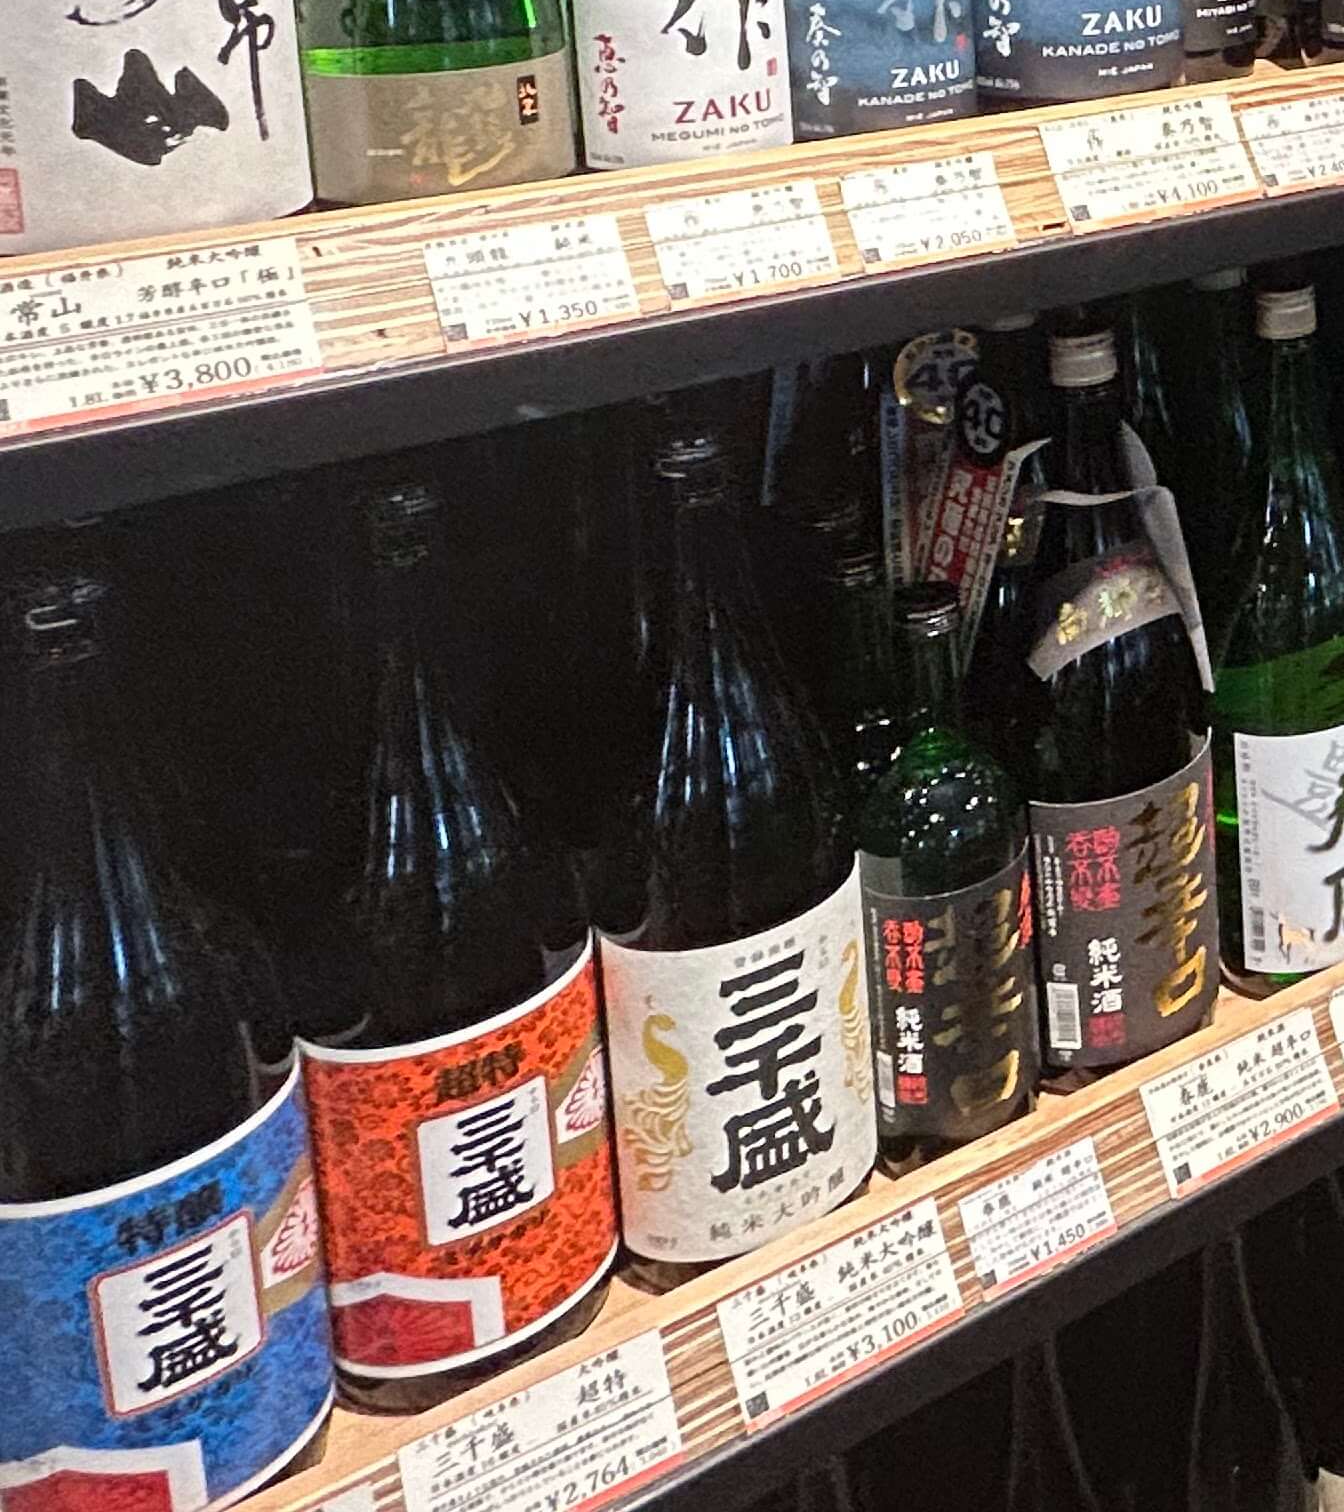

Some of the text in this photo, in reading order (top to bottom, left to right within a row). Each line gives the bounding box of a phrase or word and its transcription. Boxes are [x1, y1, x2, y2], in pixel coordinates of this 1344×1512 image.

[1081, 4, 1163, 37] ZAKU
[1042, 40, 1122, 58] KANADE
[890, 58, 961, 89] ZAKU
[672, 88, 775, 125] ZAKU
[857, 91, 926, 108] KANADE
[651, 126, 727, 144] MEGUMI
[9, 292, 83, 328] 常山
[517, 299, 599, 330] ¥1,350
[138, 356, 253, 397] ¥3,800
[1086, 937, 1125, 1015] 純米酒
[895, 1005, 925, 1074] 純米酒
[706, 949, 837, 1194] 三千盛
[1236, 1048, 1267, 1077] 純米
[1178, 1074, 1212, 1107] 春鹿
[1248, 1102, 1305, 1145] ¥2,900
[447, 1097, 535, 1228] 三千盛
[708, 1165, 847, 1244] 純米大吟醸
[838, 1219, 936, 1284] 純米大吟醸
[1030, 1223, 1086, 1262] ¥1,450
[137, 1244, 238, 1393] 三千盛
[748, 1280, 816, 1329] 三千盛
[846, 1310, 919, 1362] ¥3,100
[577, 1367, 627, 1406] 超特
[434, 1420, 515, 1479] 三千盛
[545, 1454, 630, 1512] ¥2,764
